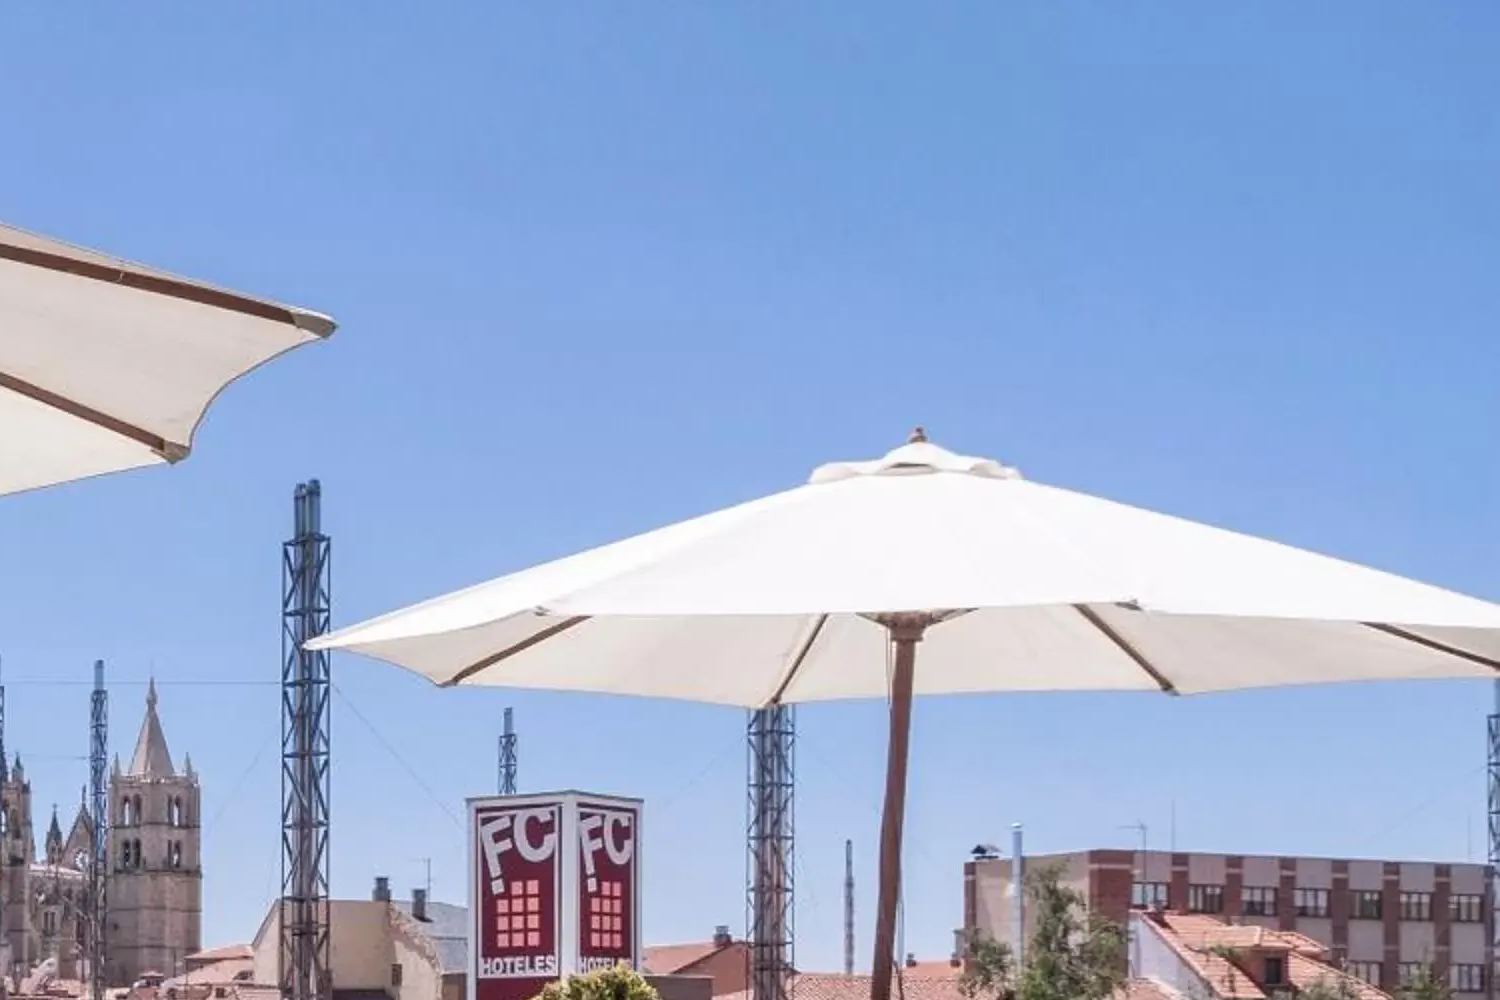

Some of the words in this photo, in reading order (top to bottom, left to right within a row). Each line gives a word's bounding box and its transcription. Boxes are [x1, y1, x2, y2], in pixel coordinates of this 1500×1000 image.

[481, 809, 557, 895] FC
[580, 812, 634, 892] FC
[482, 954, 556, 975] HOTELES
